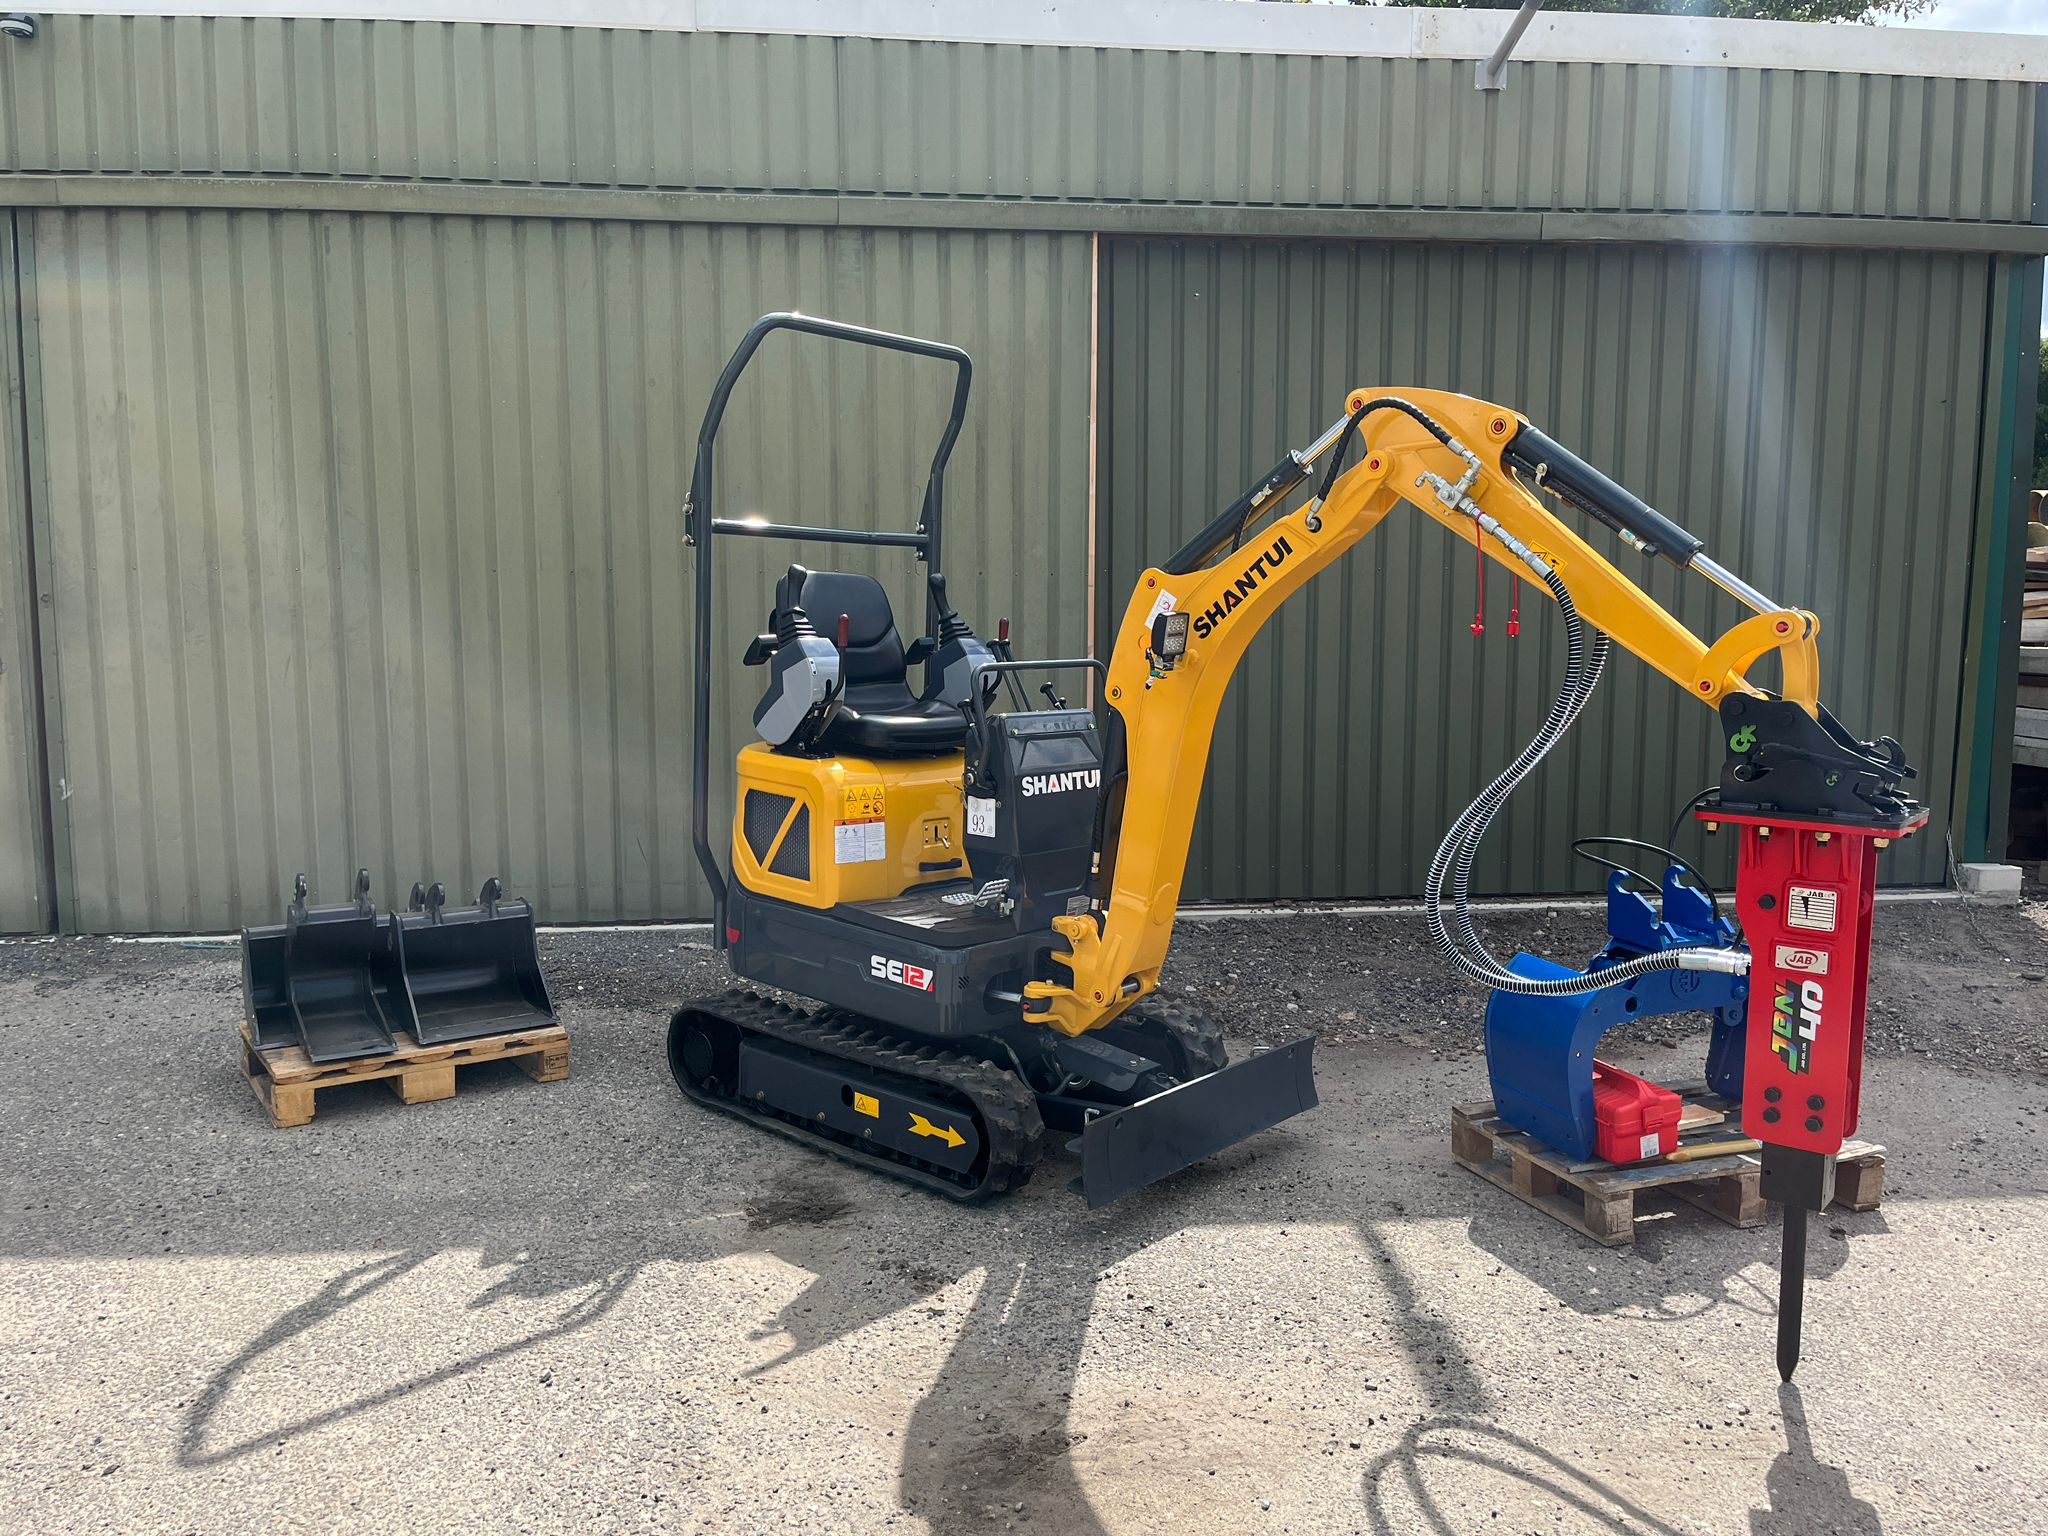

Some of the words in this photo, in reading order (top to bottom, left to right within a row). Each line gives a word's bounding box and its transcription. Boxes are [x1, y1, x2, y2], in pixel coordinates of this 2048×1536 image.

[1193, 536, 1294, 639] SHANTUI
[1021, 769, 1101, 797] SHANTUI
[972, 814, 985, 833] 93
[1807, 890, 1824, 898] JAB
[870, 954, 926, 988] SE12
[1789, 954, 1813, 965] JAB
[1798, 980, 1824, 1042] 40
